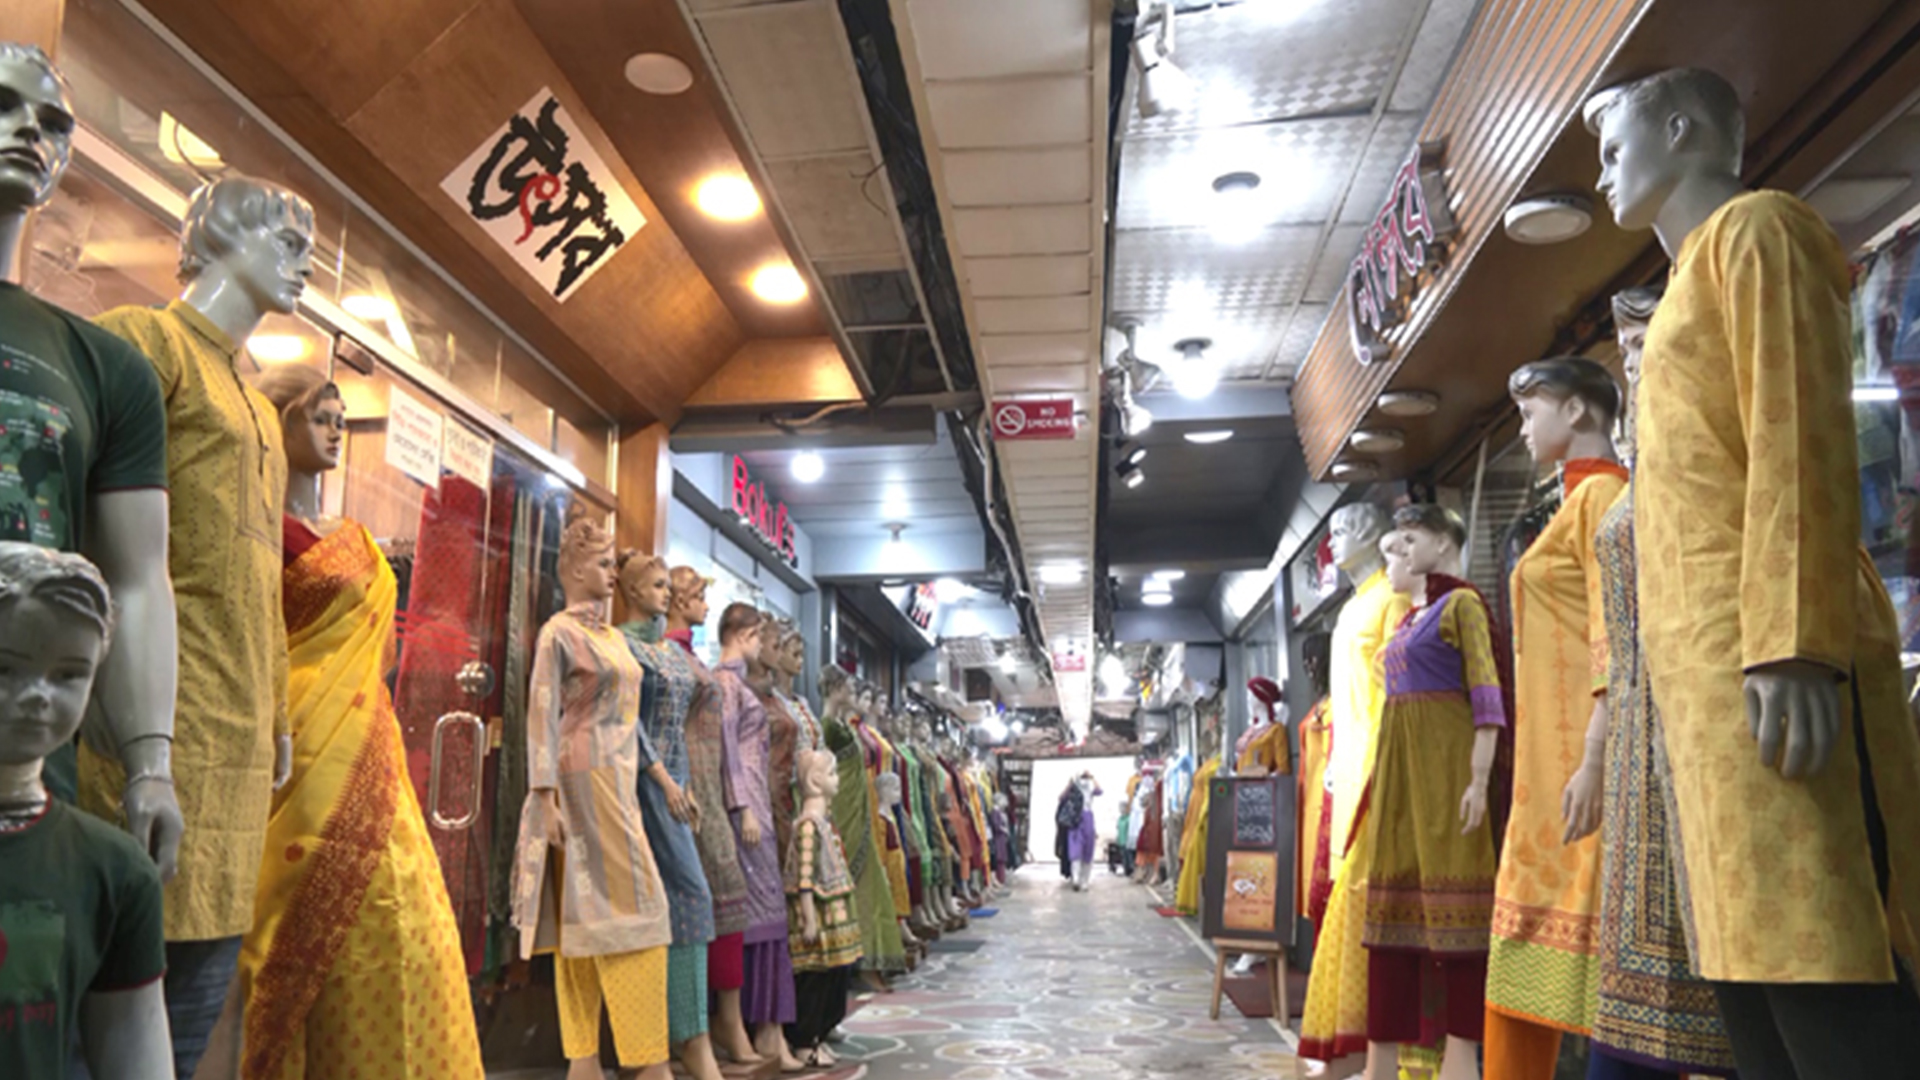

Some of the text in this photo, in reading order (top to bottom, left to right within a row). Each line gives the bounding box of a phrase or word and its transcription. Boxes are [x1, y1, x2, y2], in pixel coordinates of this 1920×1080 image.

[467, 97, 624, 296] উৎসব
[1039, 406, 1057, 417] NO
[1026, 418, 1070, 429] SMOKING
